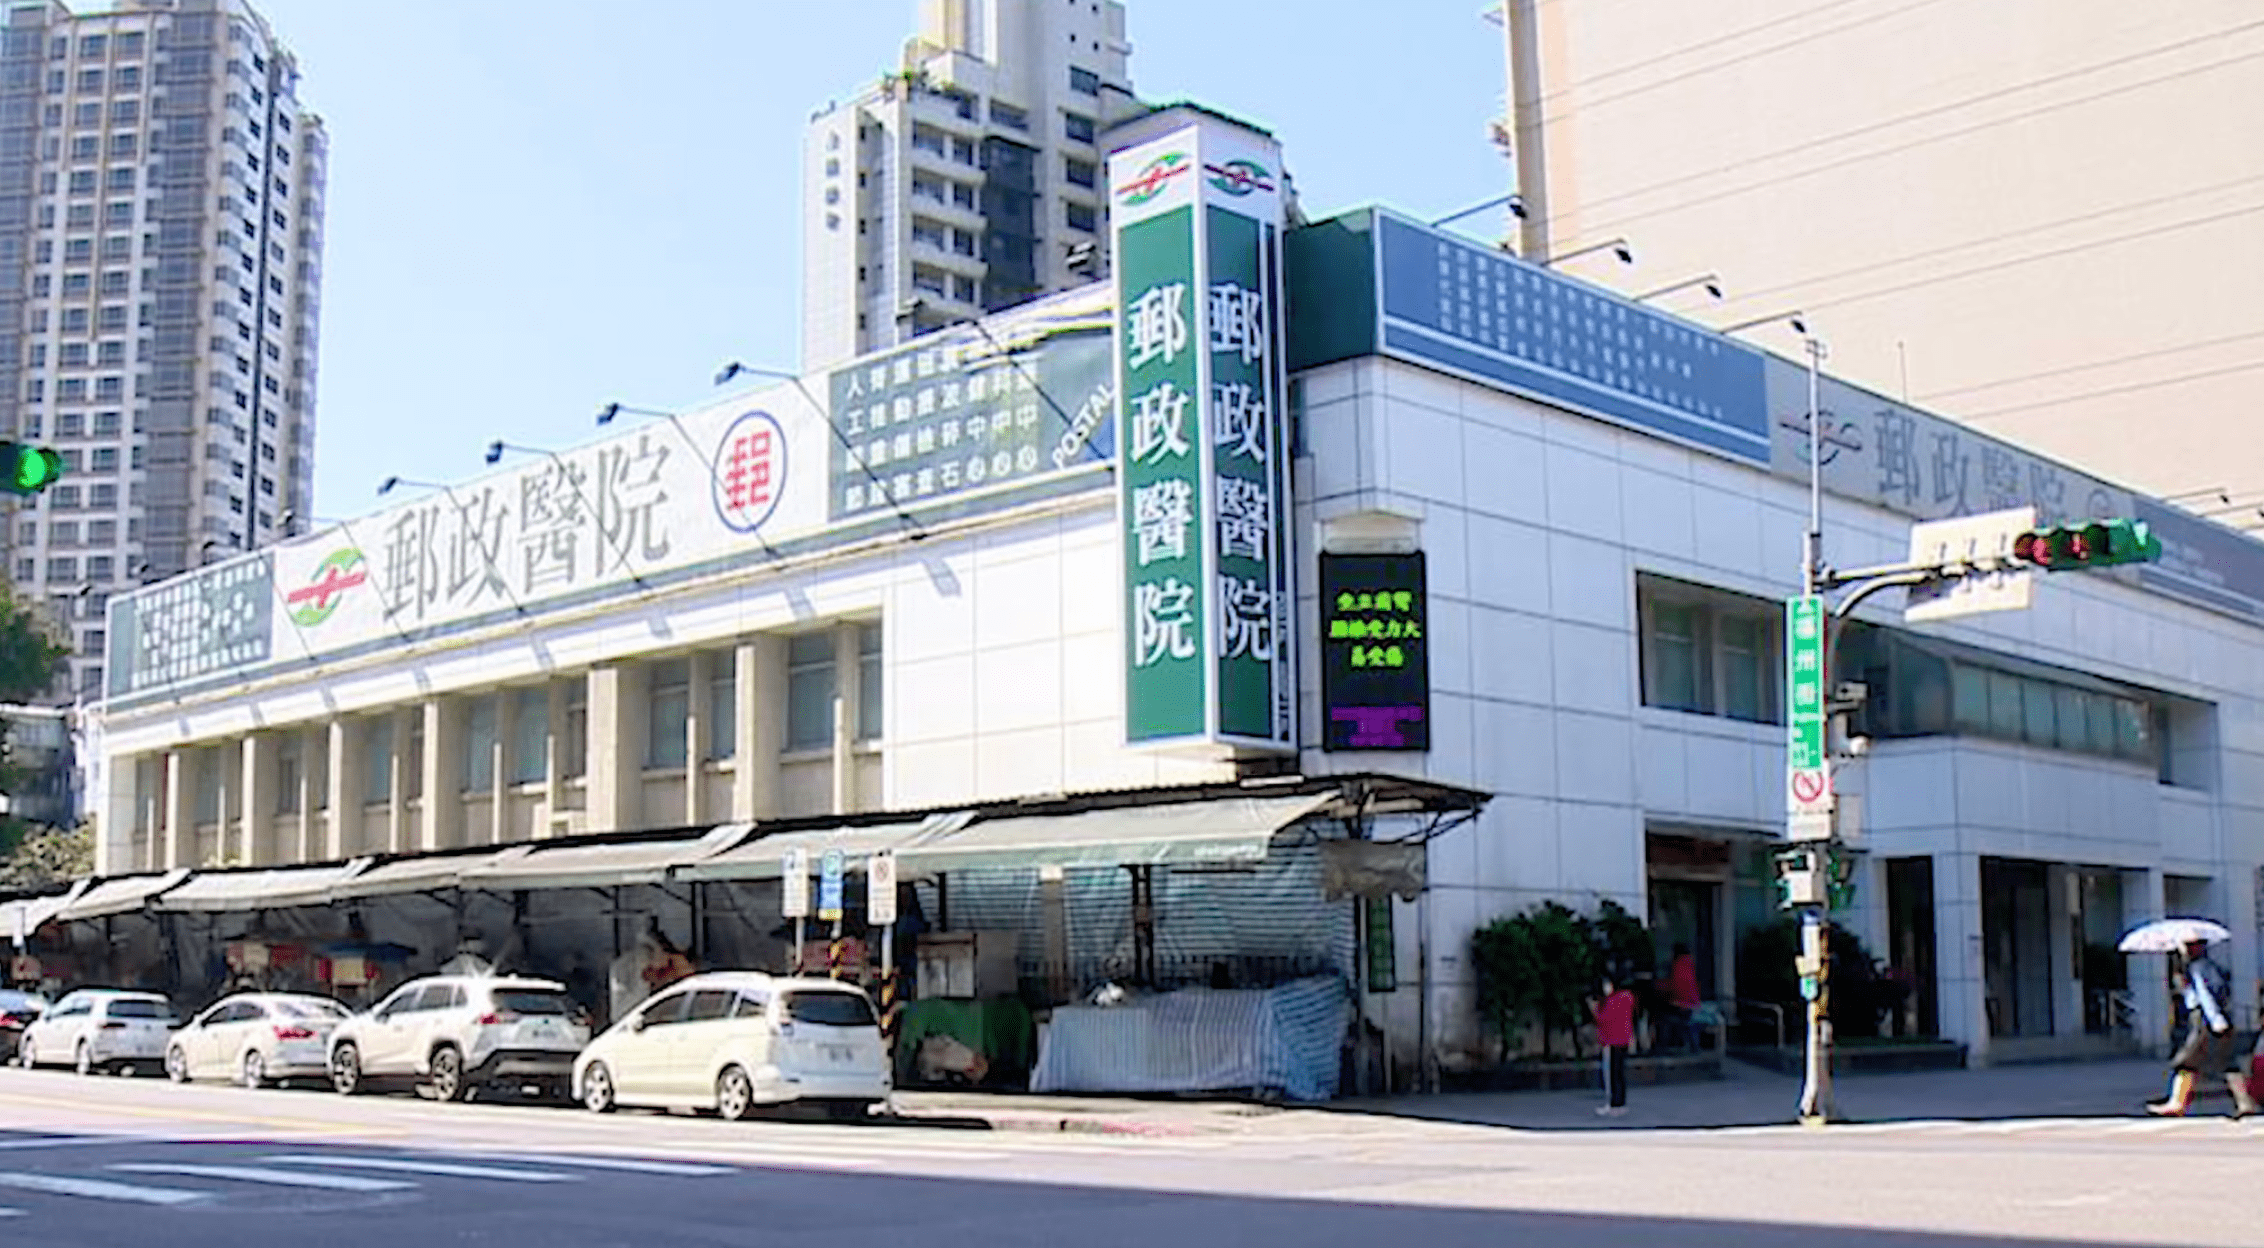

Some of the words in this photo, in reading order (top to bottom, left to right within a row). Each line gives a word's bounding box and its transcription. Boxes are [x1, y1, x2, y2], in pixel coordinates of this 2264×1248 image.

[726, 430, 771, 511] 郵
[1052, 383, 1114, 471] POSTAL
[1128, 282, 1195, 667] 郵政醫院
[1210, 283, 1270, 661] 郵政醫院
[383, 434, 671, 620] 郵政醫院
